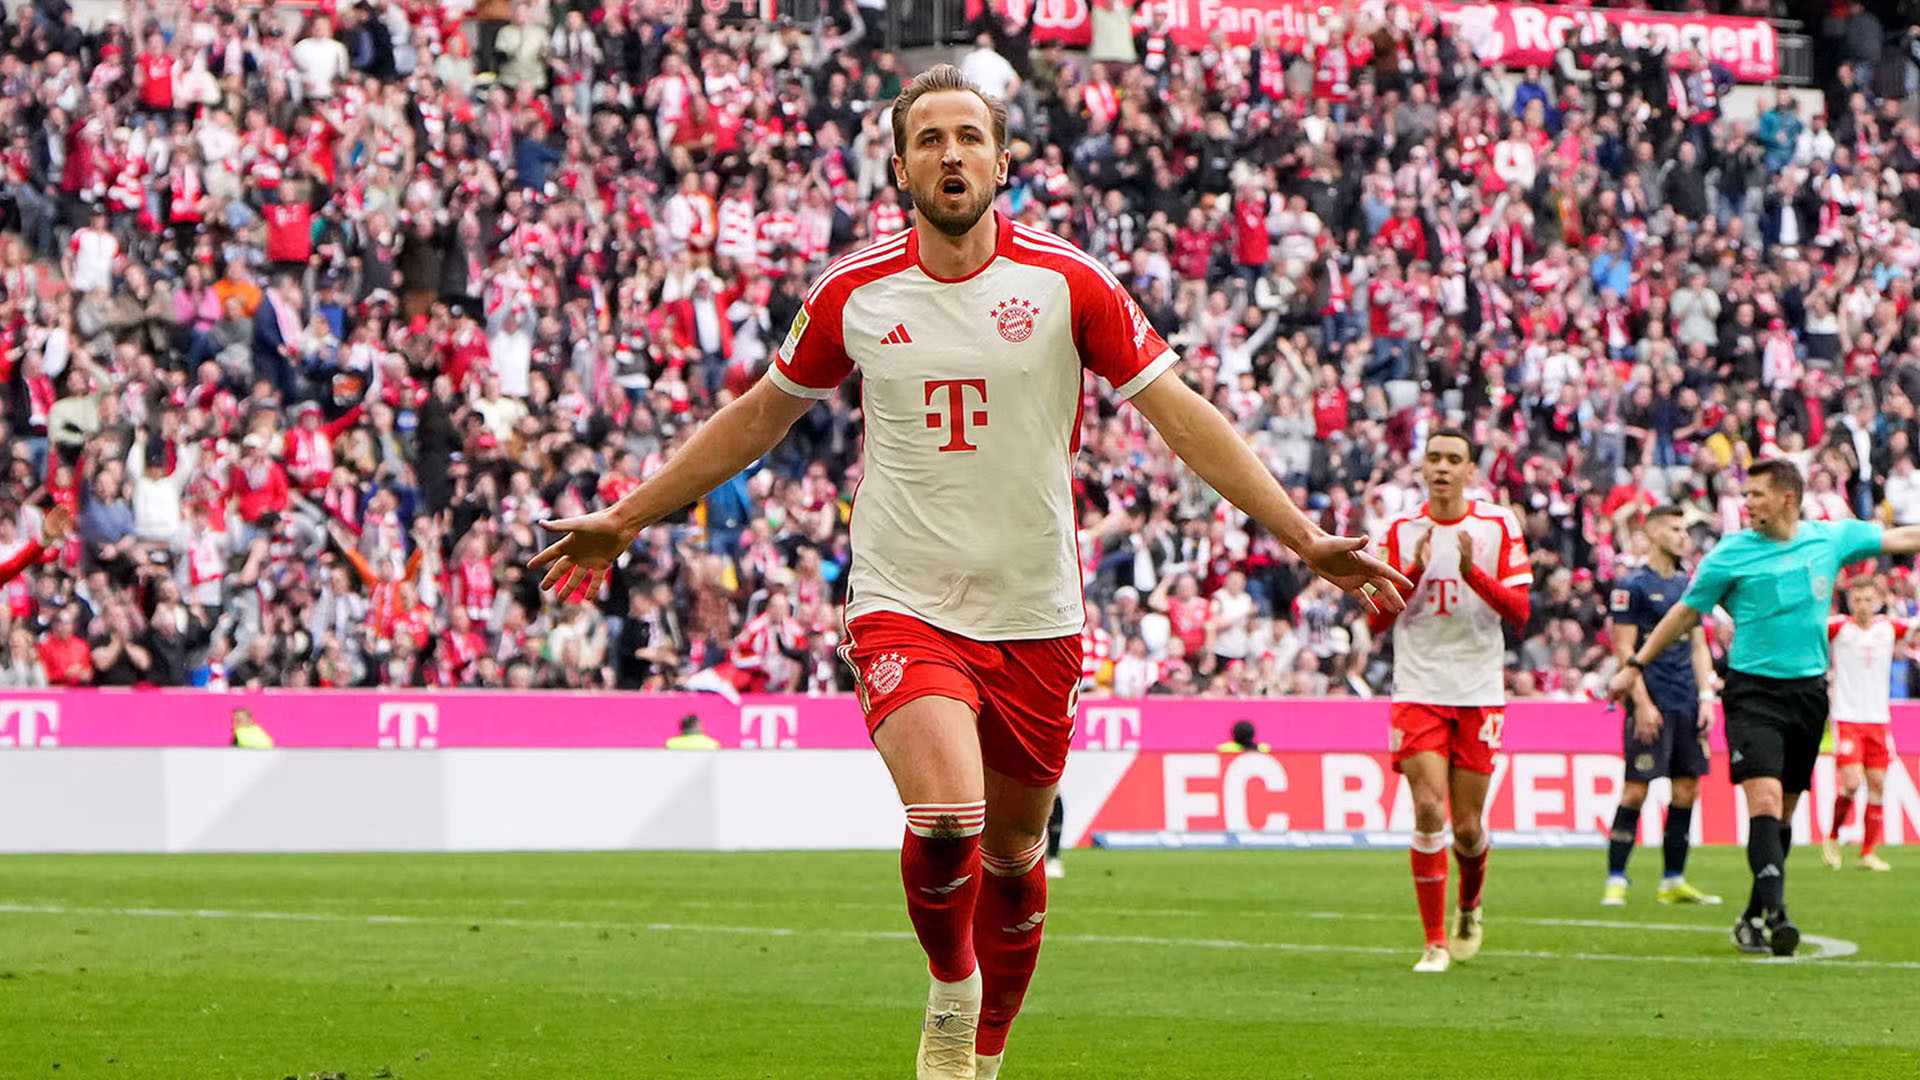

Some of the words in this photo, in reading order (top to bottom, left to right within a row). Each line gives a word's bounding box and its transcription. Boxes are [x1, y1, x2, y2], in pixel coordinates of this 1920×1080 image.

[1201, 0, 1332, 41] Fanclu
[924, 379, 988, 452] T
[1426, 578, 1459, 616] T
[379, 703, 437, 748] T
[740, 706, 797, 749] T
[1086, 708, 1140, 750] T
[1163, 753, 1290, 832] FC
